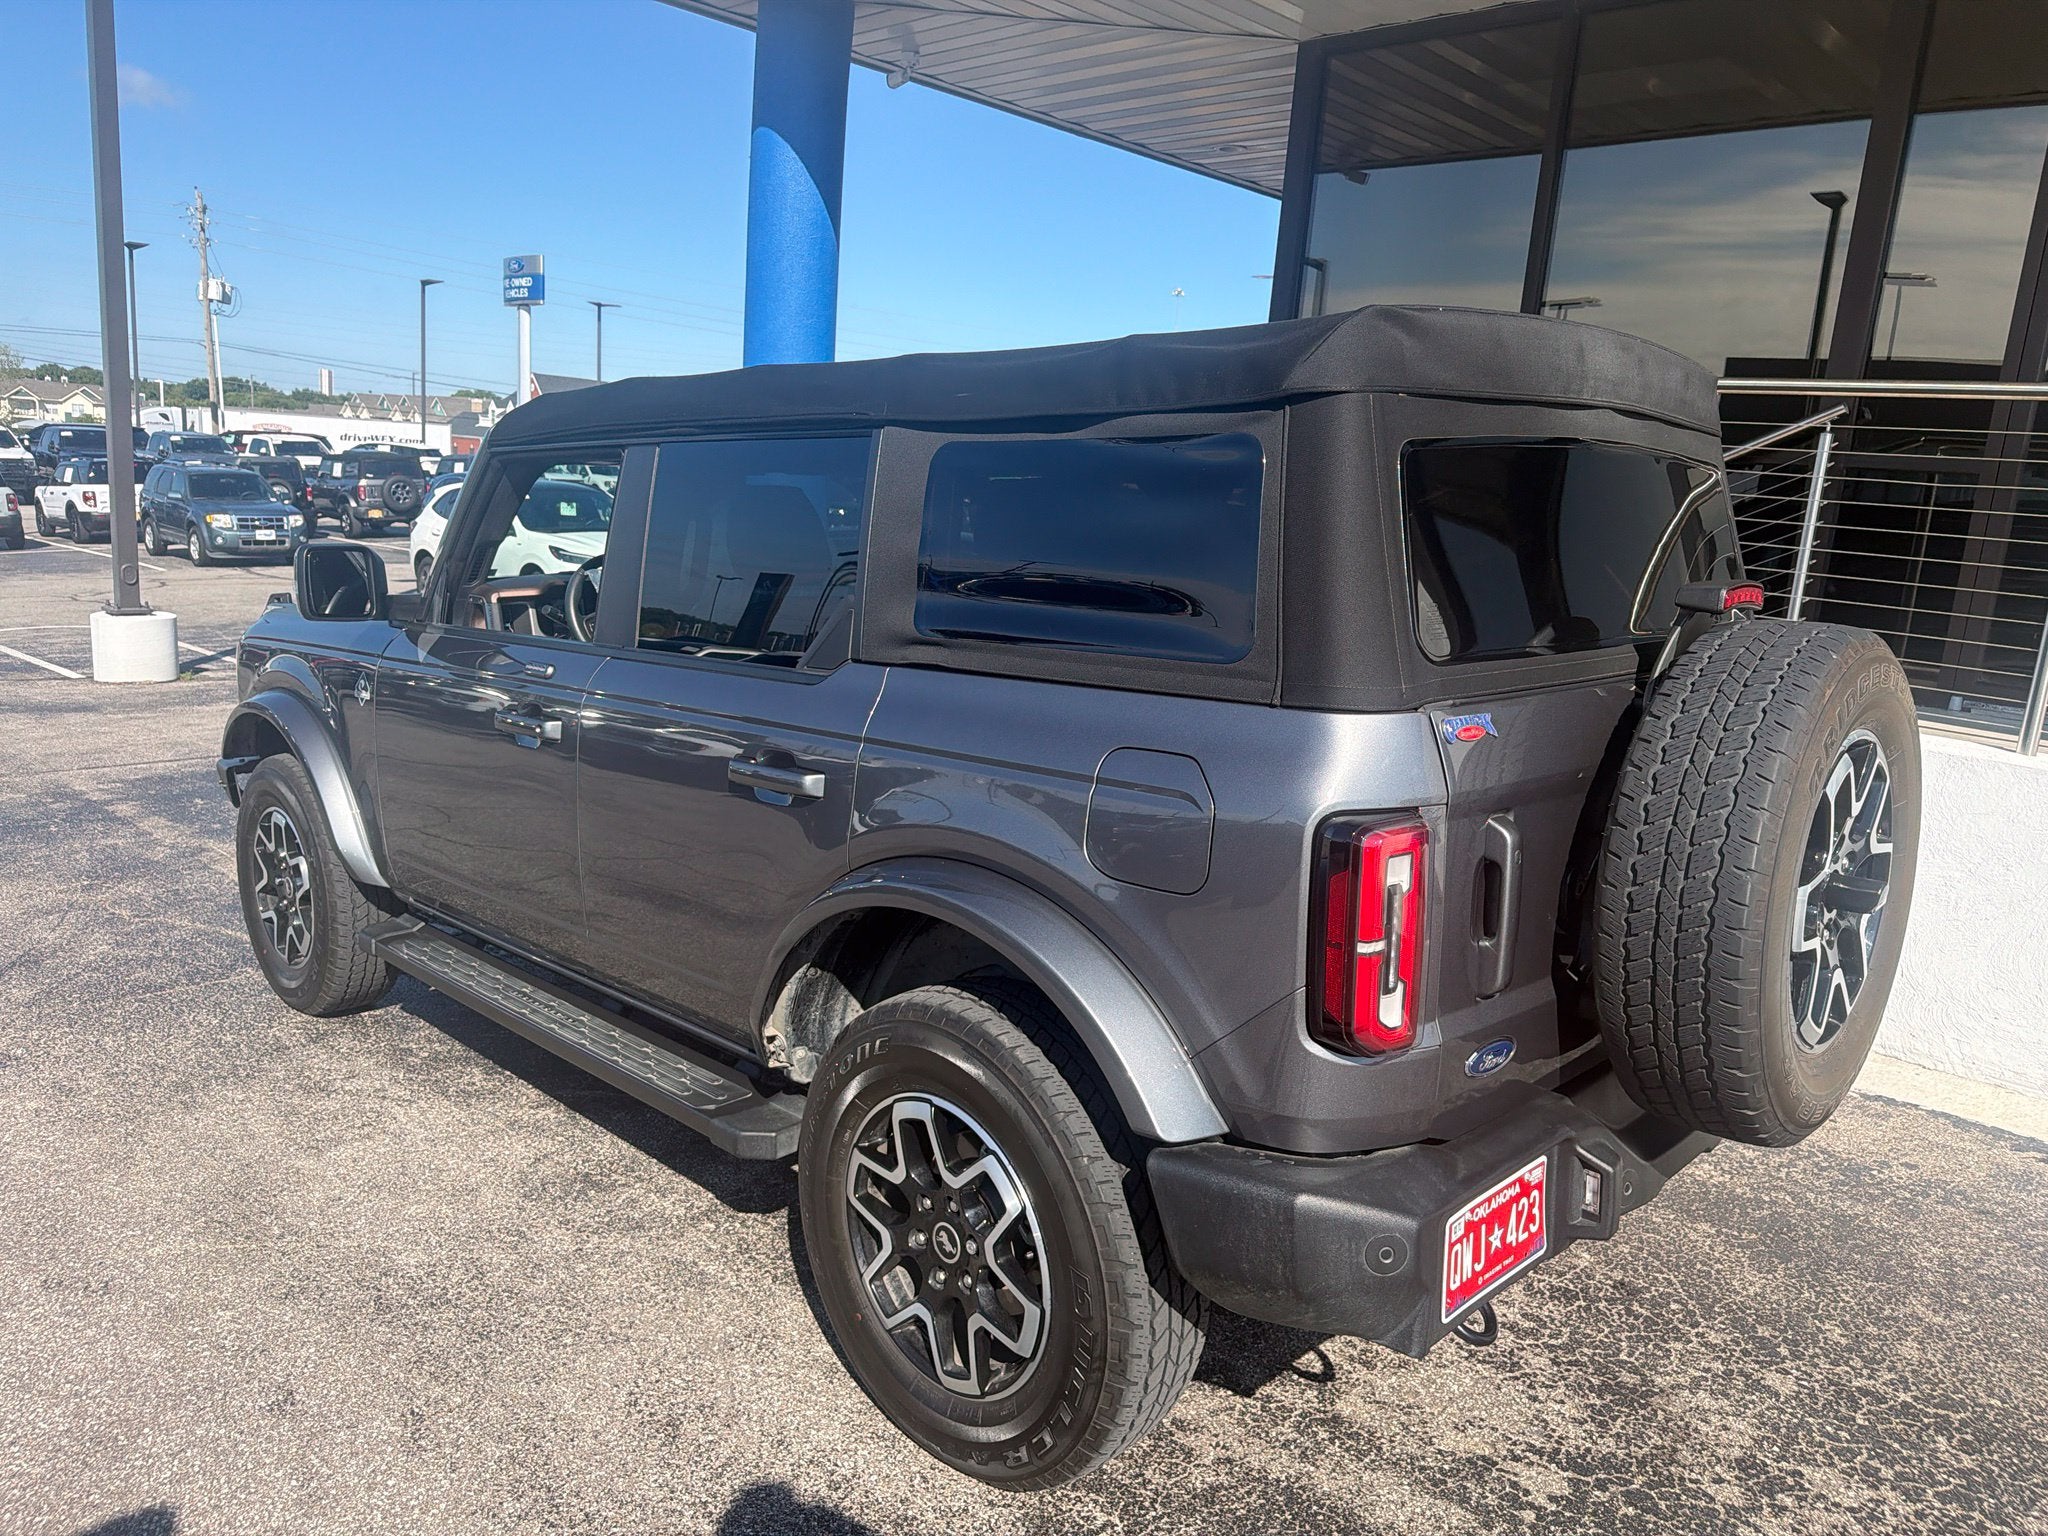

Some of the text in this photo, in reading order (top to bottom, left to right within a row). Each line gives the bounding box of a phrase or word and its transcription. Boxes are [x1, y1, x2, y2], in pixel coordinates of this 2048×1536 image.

[504, 277, 533, 288] E-OWNED
[505, 288, 529, 298] EHICLES
[1478, 1048, 1507, 1072] Ford
[1472, 1181, 1521, 1223] OKLAHOMA
